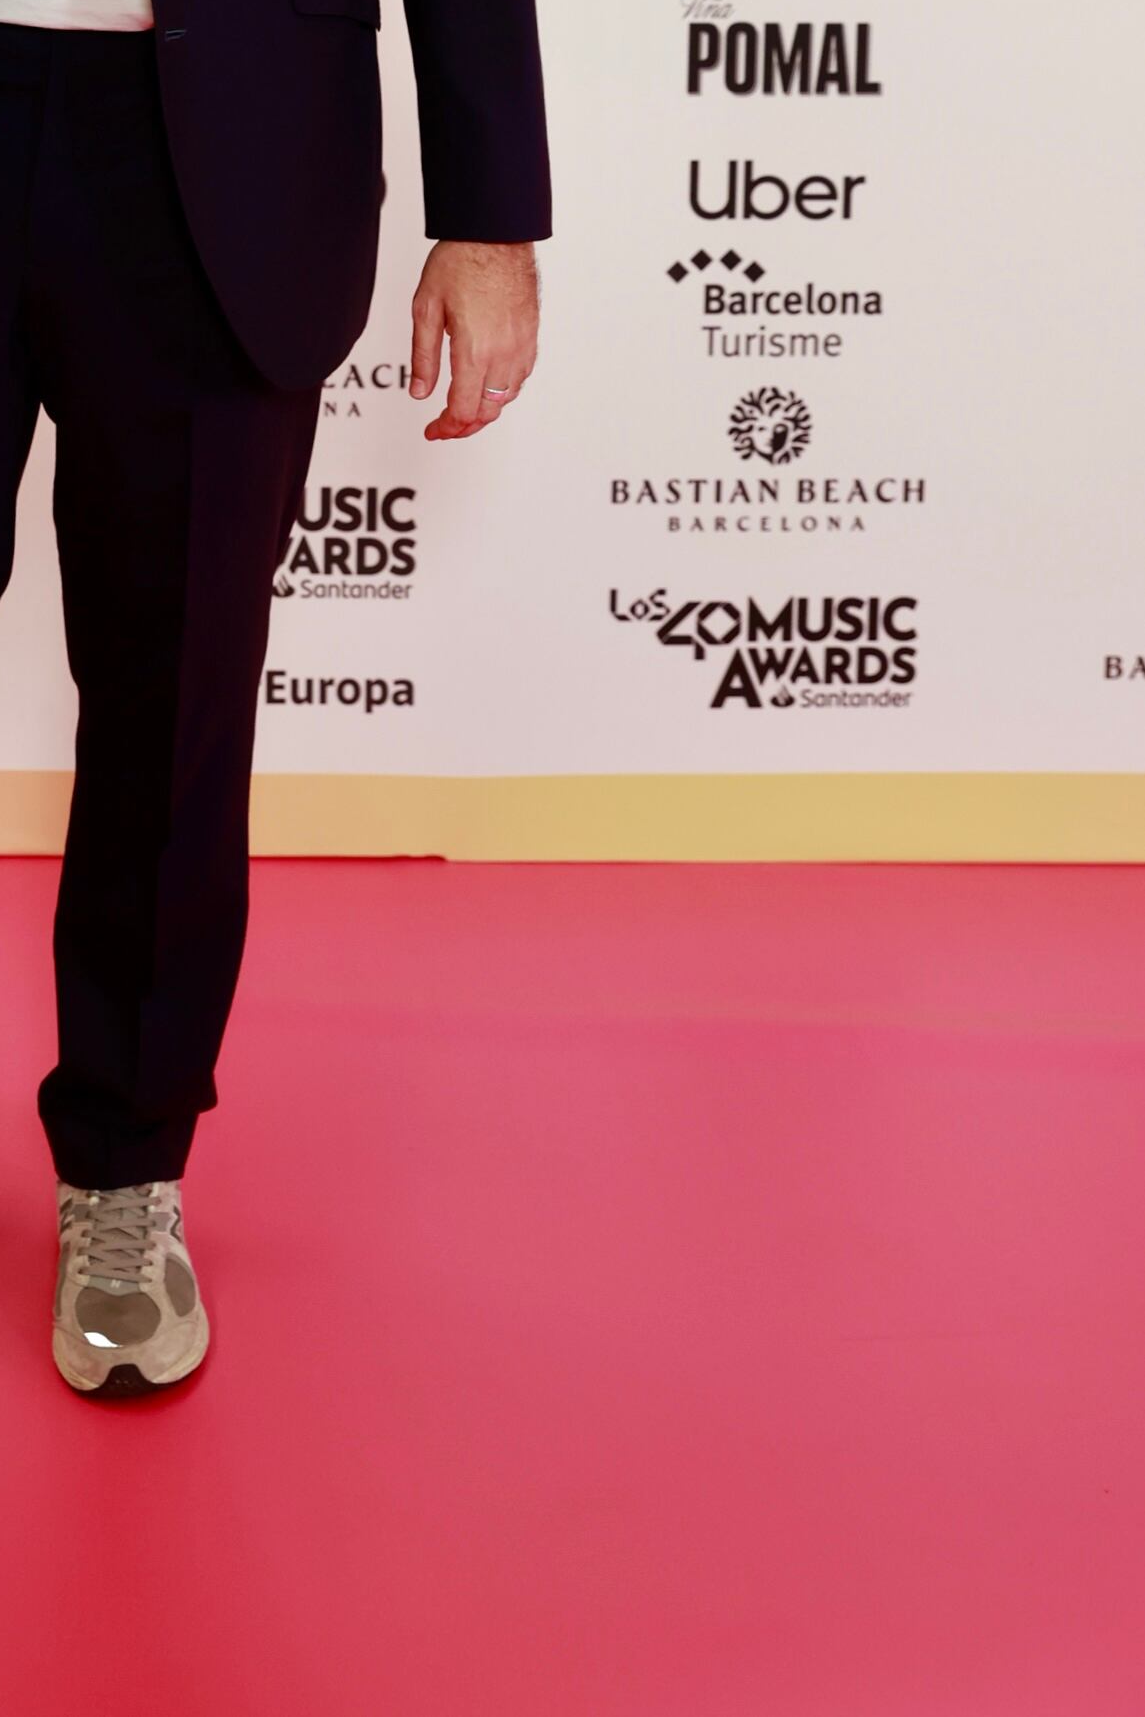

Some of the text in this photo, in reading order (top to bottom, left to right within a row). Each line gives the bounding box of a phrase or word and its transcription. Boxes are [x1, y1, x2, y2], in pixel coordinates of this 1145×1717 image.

[687, 21, 882, 96] POMAL
[689, 160, 866, 221] Uber
[704, 283, 883, 316] Barcelona
[701, 325, 843, 358] Turisme
[611, 479, 925, 504] BASTIAN BEACH
[667, 516, 865, 533] BARCELONA
[300, 579, 413, 600] Santander
[747, 596, 918, 643] MUSIC
[709, 645, 919, 708] AWARDS
[800, 682, 912, 709] Santander
